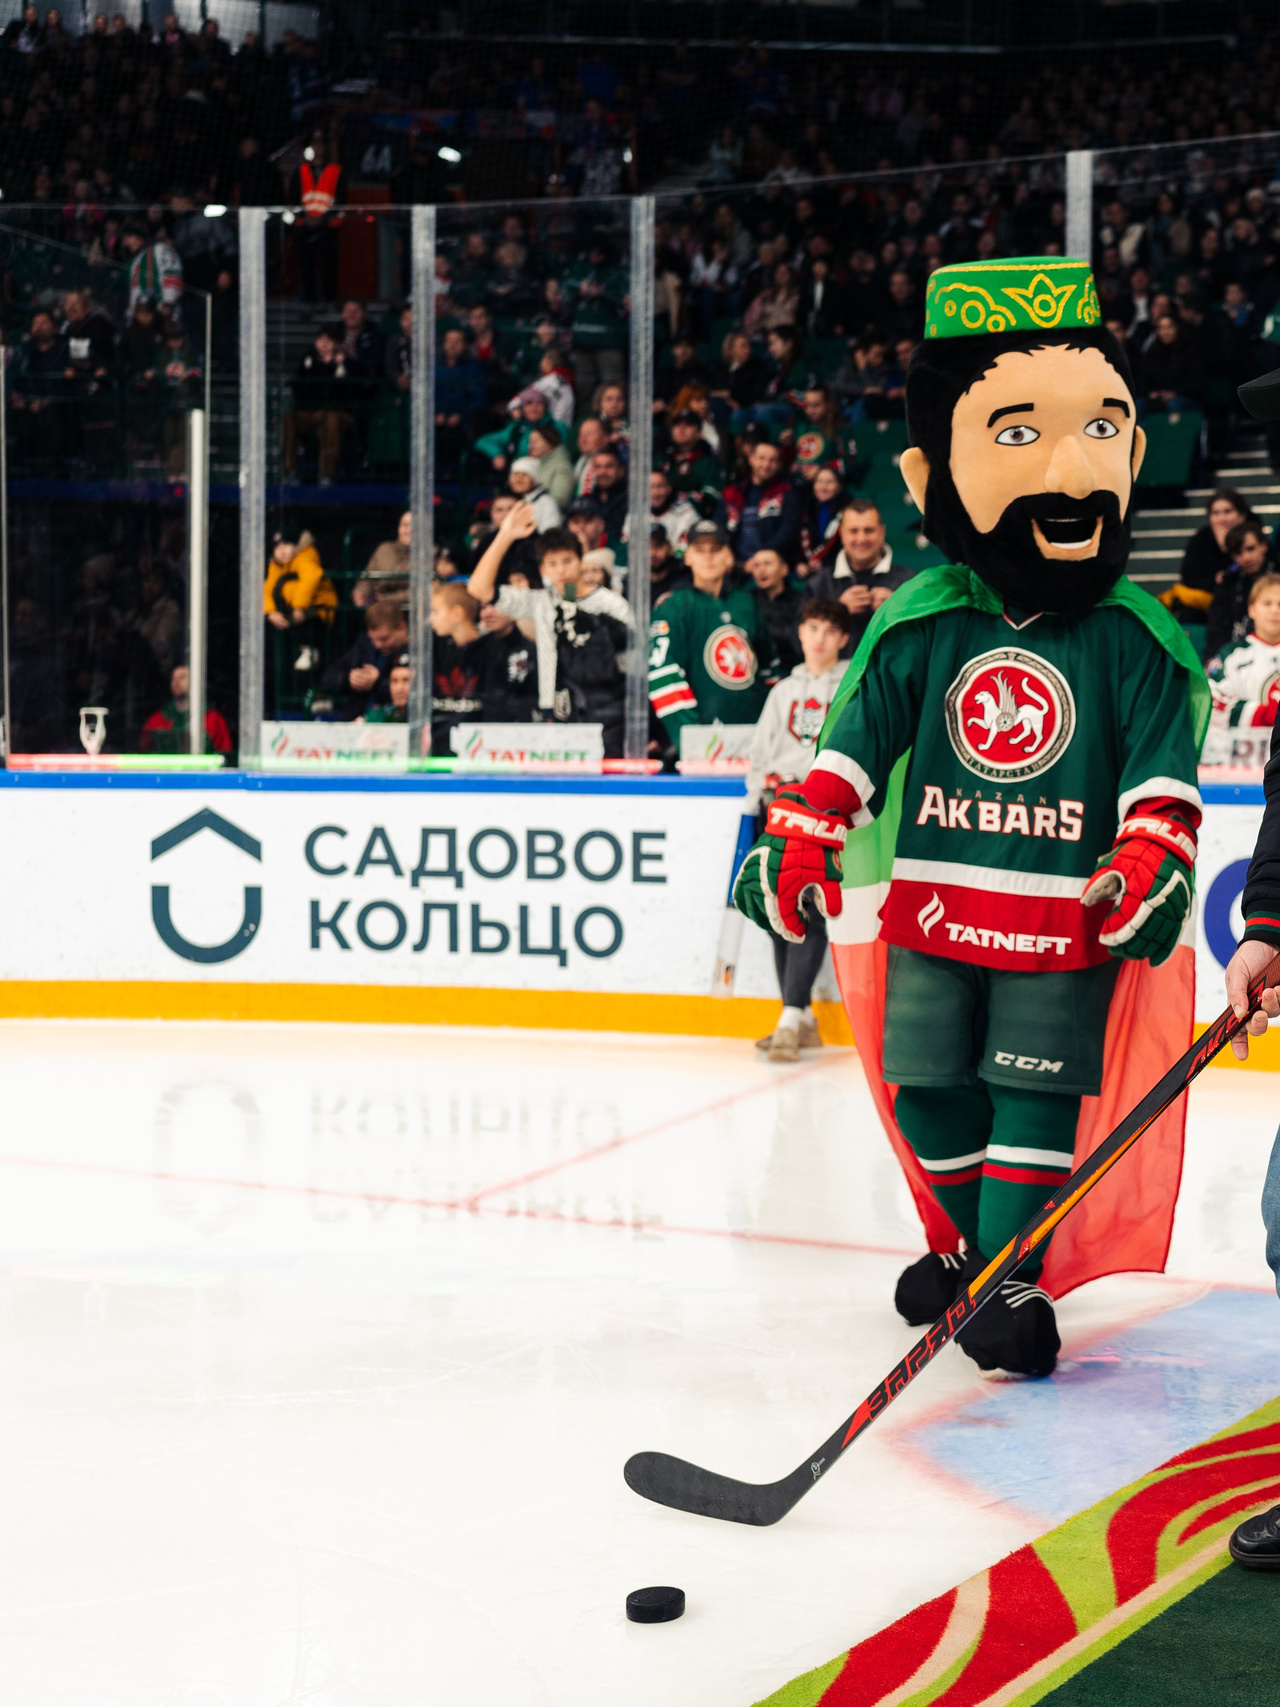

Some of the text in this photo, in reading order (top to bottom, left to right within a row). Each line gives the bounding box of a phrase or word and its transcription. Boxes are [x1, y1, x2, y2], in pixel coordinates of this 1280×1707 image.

[293, 746, 397, 763] TATNEFT
[488, 749, 589, 764] TATNEFT
[956, 788, 1047, 804] KAZAN
[916, 785, 1084, 842] AK BARS
[305, 826, 668, 889] САДОВОЕ
[310, 900, 624, 967] КОЛЬЦО
[945, 922, 1072, 955] TATNEFT
[994, 1050, 1064, 1074] CCM
